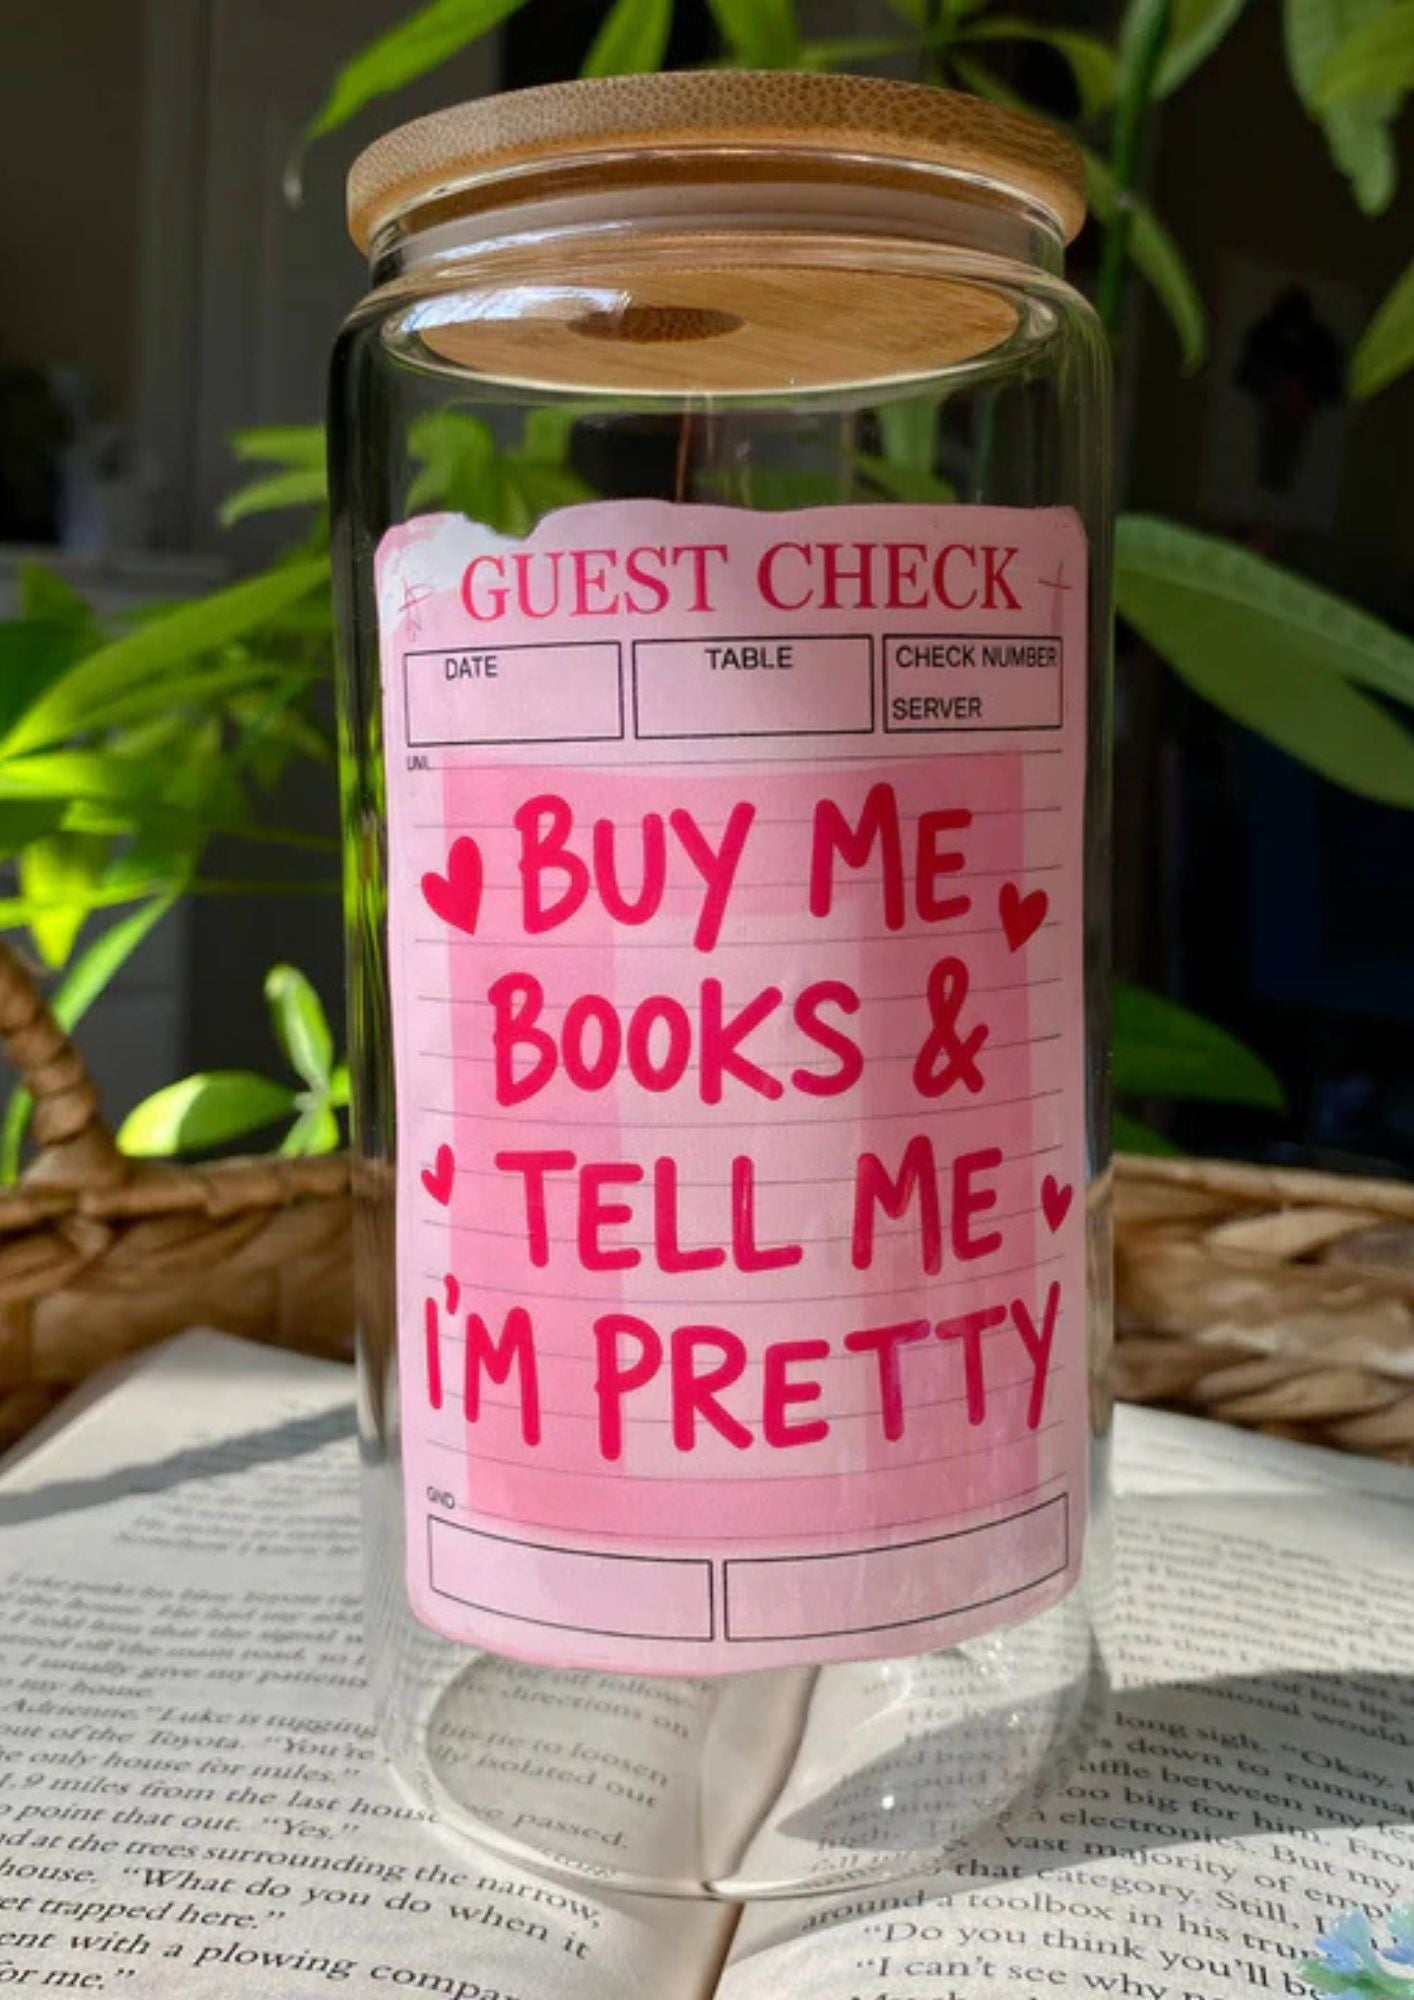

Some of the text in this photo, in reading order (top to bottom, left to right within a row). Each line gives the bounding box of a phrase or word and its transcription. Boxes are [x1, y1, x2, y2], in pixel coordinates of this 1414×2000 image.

[461, 541, 1022, 622] GUEST CHECK
[445, 656, 498, 681] DATE
[705, 646, 793, 670] TABLE
[895, 645, 1058, 668] CHECK NUMBER
[892, 697, 982, 719] SERVER
[514, 782, 972, 953] BUY ME
[488, 957, 990, 1106] BOOKS &
[495, 1134, 1003, 1276] TELL ME
[425, 1273, 1061, 1462] I'M PRETTY
[1116, 1711, 1188, 1739] long
[29, 1749, 98, 1768] only
[104, 1751, 191, 1772] house
[1126, 1736, 1222, 1768] down
[1236, 1759, 1271, 1777] to
[50, 1775, 131, 1794] miles
[140, 1779, 215, 1801] from
[225, 1786, 278, 1805] the
[287, 1790, 341, 1812] last
[605, 1779, 657, 1808] out
[1123, 1785, 1180, 1814] big
[1190, 1796, 1241, 1822] for
[1161, 1766, 1303, 1812] between
[1314, 1803, 1365, 1831] my
[13, 1802, 106, 1822] point
[111, 1806, 175, 1828] that
[67, 1833, 120, 1853] the
[125, 1841, 200, 1860] trees
[202, 1847, 409, 1882] surrounding
[415, 1864, 468, 1885] the
[1004, 1835, 1071, 1852] vast
[1084, 1840, 1237, 1883] majority
[1254, 1873, 1296, 1894] of
[1058, 1807, 1258, 1855] electronics.
[1272, 1843, 1336, 1876] But
[1347, 1868, 1401, 1898] my
[39, 1899, 175, 1923] trapped
[801, 1888, 926, 1932] around
[936, 1894, 954, 1908] a
[968, 1892, 1114, 1921] toolbox
[1128, 1903, 1164, 1929] in
[1178, 1911, 1230, 1942] his
[955, 1858, 1024, 1879] that
[1314, 1914, 1327, 1936] I
[245, 1876, 292, 1898] do
[300, 1887, 371, 1907] you
[384, 1892, 431, 1914] do
[449, 1903, 548, 1942] when
[563, 1931, 591, 1961] it
[71, 1930, 151, 1955] with
[162, 1942, 184, 1958] a
[192, 1941, 358, 1981] plowing
[959, 1926, 1026, 1947] you
[1042, 1928, 1146, 1961] think
[1007, 1963, 1069, 1986] see
[1082, 1972, 1168, 2000] why
